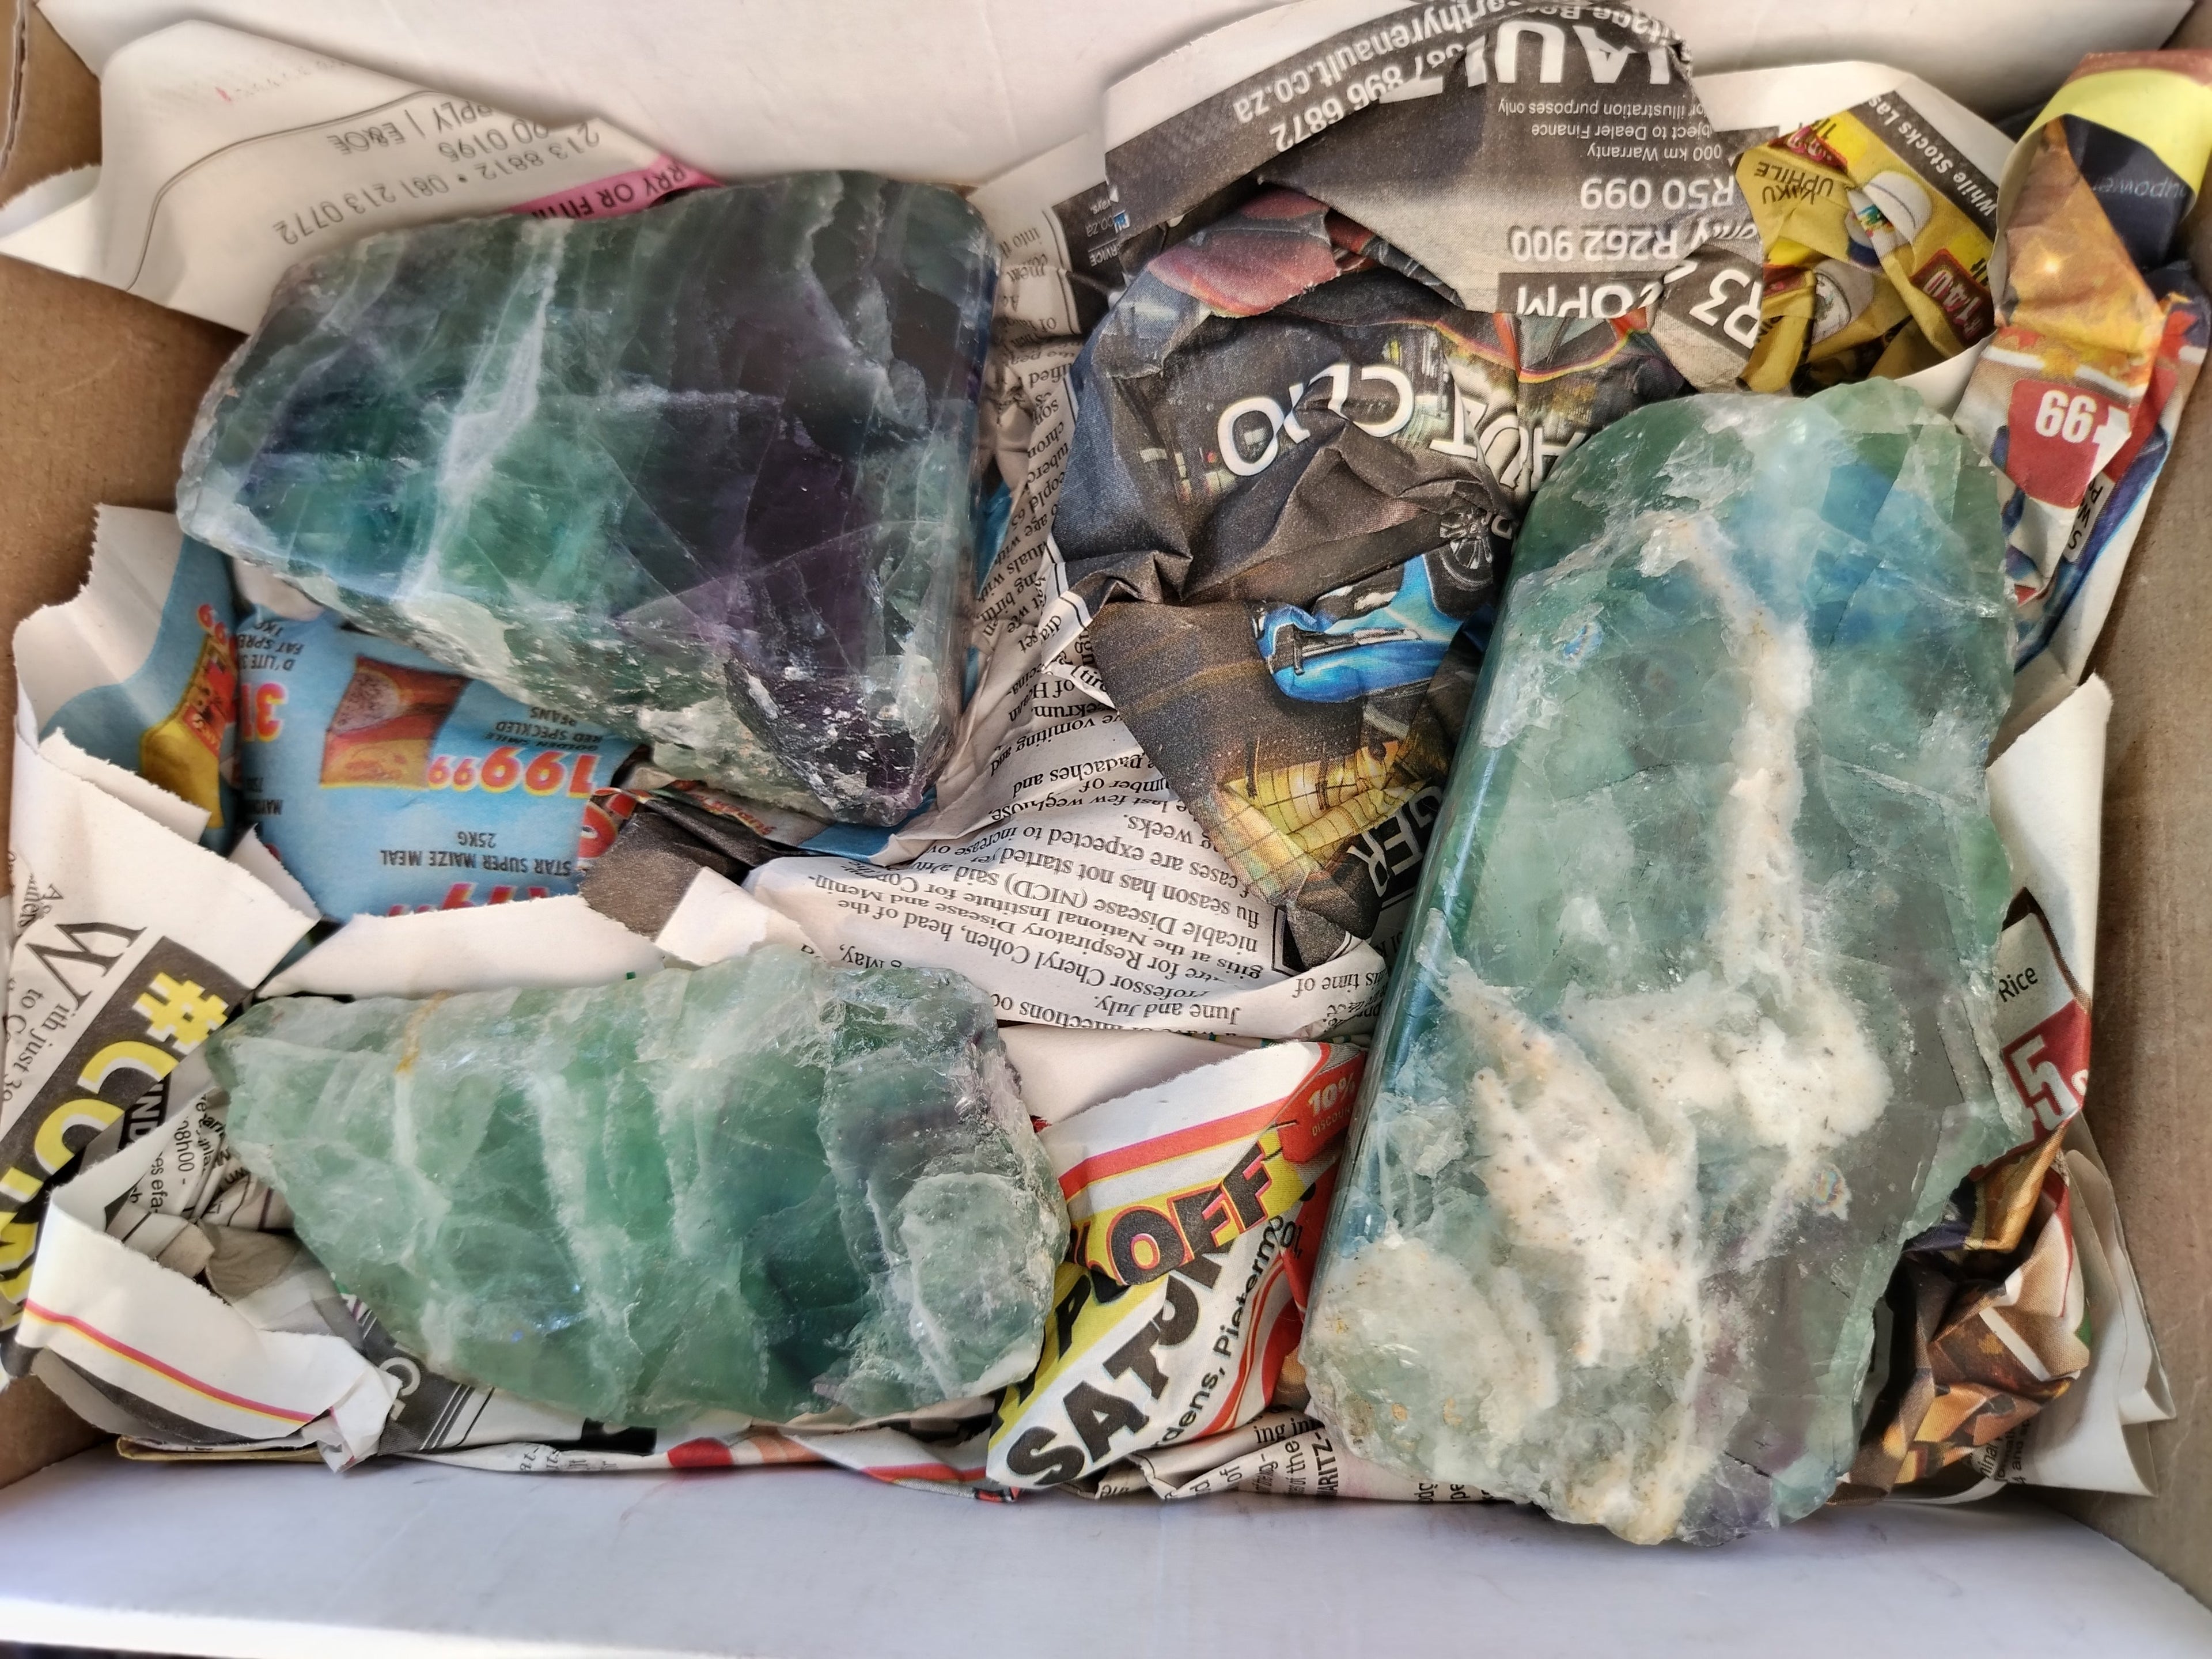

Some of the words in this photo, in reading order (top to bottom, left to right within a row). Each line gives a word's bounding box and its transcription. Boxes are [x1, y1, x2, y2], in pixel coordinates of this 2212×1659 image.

[1347, 67, 1403, 111] 896
[1498, 99, 1524, 115] only
[1528, 100, 1599, 115] purposes
[1603, 104, 1684, 120] illustration
[1268, 97, 1344, 152] 6872
[1531, 123, 1590, 139] Finance
[1595, 125, 1647, 139] Dealer
[1652, 126, 1667, 138] to
[327, 122, 407, 155] E&OE
[1899, 120, 1953, 173] Stocks
[1586, 143, 1658, 162] Warranty
[1663, 147, 1688, 162] km
[474, 150, 544, 180] 8812
[345, 182, 397, 215] 213
[403, 175, 450, 198] 081
[596, 183, 635, 209] OR
[1580, 177, 1651, 210] 099
[1952, 171, 1998, 217] While
[272, 201, 344, 245] 0772
[1510, 226, 1574, 260] 900
[1583, 229, 1678, 260] R262
[275, 641, 305, 656] FAT
[1052, 680, 1075, 699] of
[495, 721, 567, 740] SPECKLED
[1016, 718, 1096, 751] vomiting
[1012, 772, 1044, 798] and
[1078, 778, 1104, 793] of
[456, 831, 498, 849] 25KG
[1023, 827, 1043, 845] to
[1123, 814, 1194, 845] weeks.
[954, 827, 1018, 857] increase
[1047, 828, 1145, 862] expected
[379, 850, 423, 867] MEAL
[428, 850, 477, 869] MAIZE
[483, 854, 529, 874] SUPER
[533, 857, 572, 877] STAR
[998, 848, 1074, 876] started
[1149, 852, 1184, 874] are
[953, 865, 1000, 887] said
[1078, 864, 1115, 884] not
[1188, 862, 1239, 891] cases
[808, 874, 884, 902] Menin-
[923, 883, 958, 900] for
[1005, 872, 1088, 910] (NICD)
[1119, 874, 1157, 902] has
[1162, 884, 1231, 916] season
[836, 900, 870, 915] the
[889, 893, 930, 908] and
[963, 892, 1051, 923] Institute
[873, 906, 899, 921] of
[934, 902, 1018, 935] Disease
[1092, 899, 1179, 936] Disease
[1236, 906, 1260, 930] flu
[902, 911, 952, 942] head
[1056, 911, 1149, 948] National
[960, 925, 1031, 964] Cohen,
[1021, 922, 1143, 972] Respiratory
[1152, 938, 1186, 957] the
[1182, 922, 1257, 956] nicable
[1033, 950, 1105, 987] Cheryl
[1146, 956, 1180, 980] for
[1190, 950, 1211, 964] at
[1216, 958, 1264, 980] gitis
[1291, 978, 1316, 998] of
[1321, 973, 1360, 993] time
[1998, 967, 2039, 1003] Rice
[20, 988, 45, 1009] to
[1093, 995, 1141, 1017] July.
[1142, 1002, 1183, 1018] and
[1188, 1003, 1241, 1025] June
[13, 1028, 54, 1073] just
[1106, 1139, 1273, 1286] OFF
[1285, 1439, 1306, 1475] the
